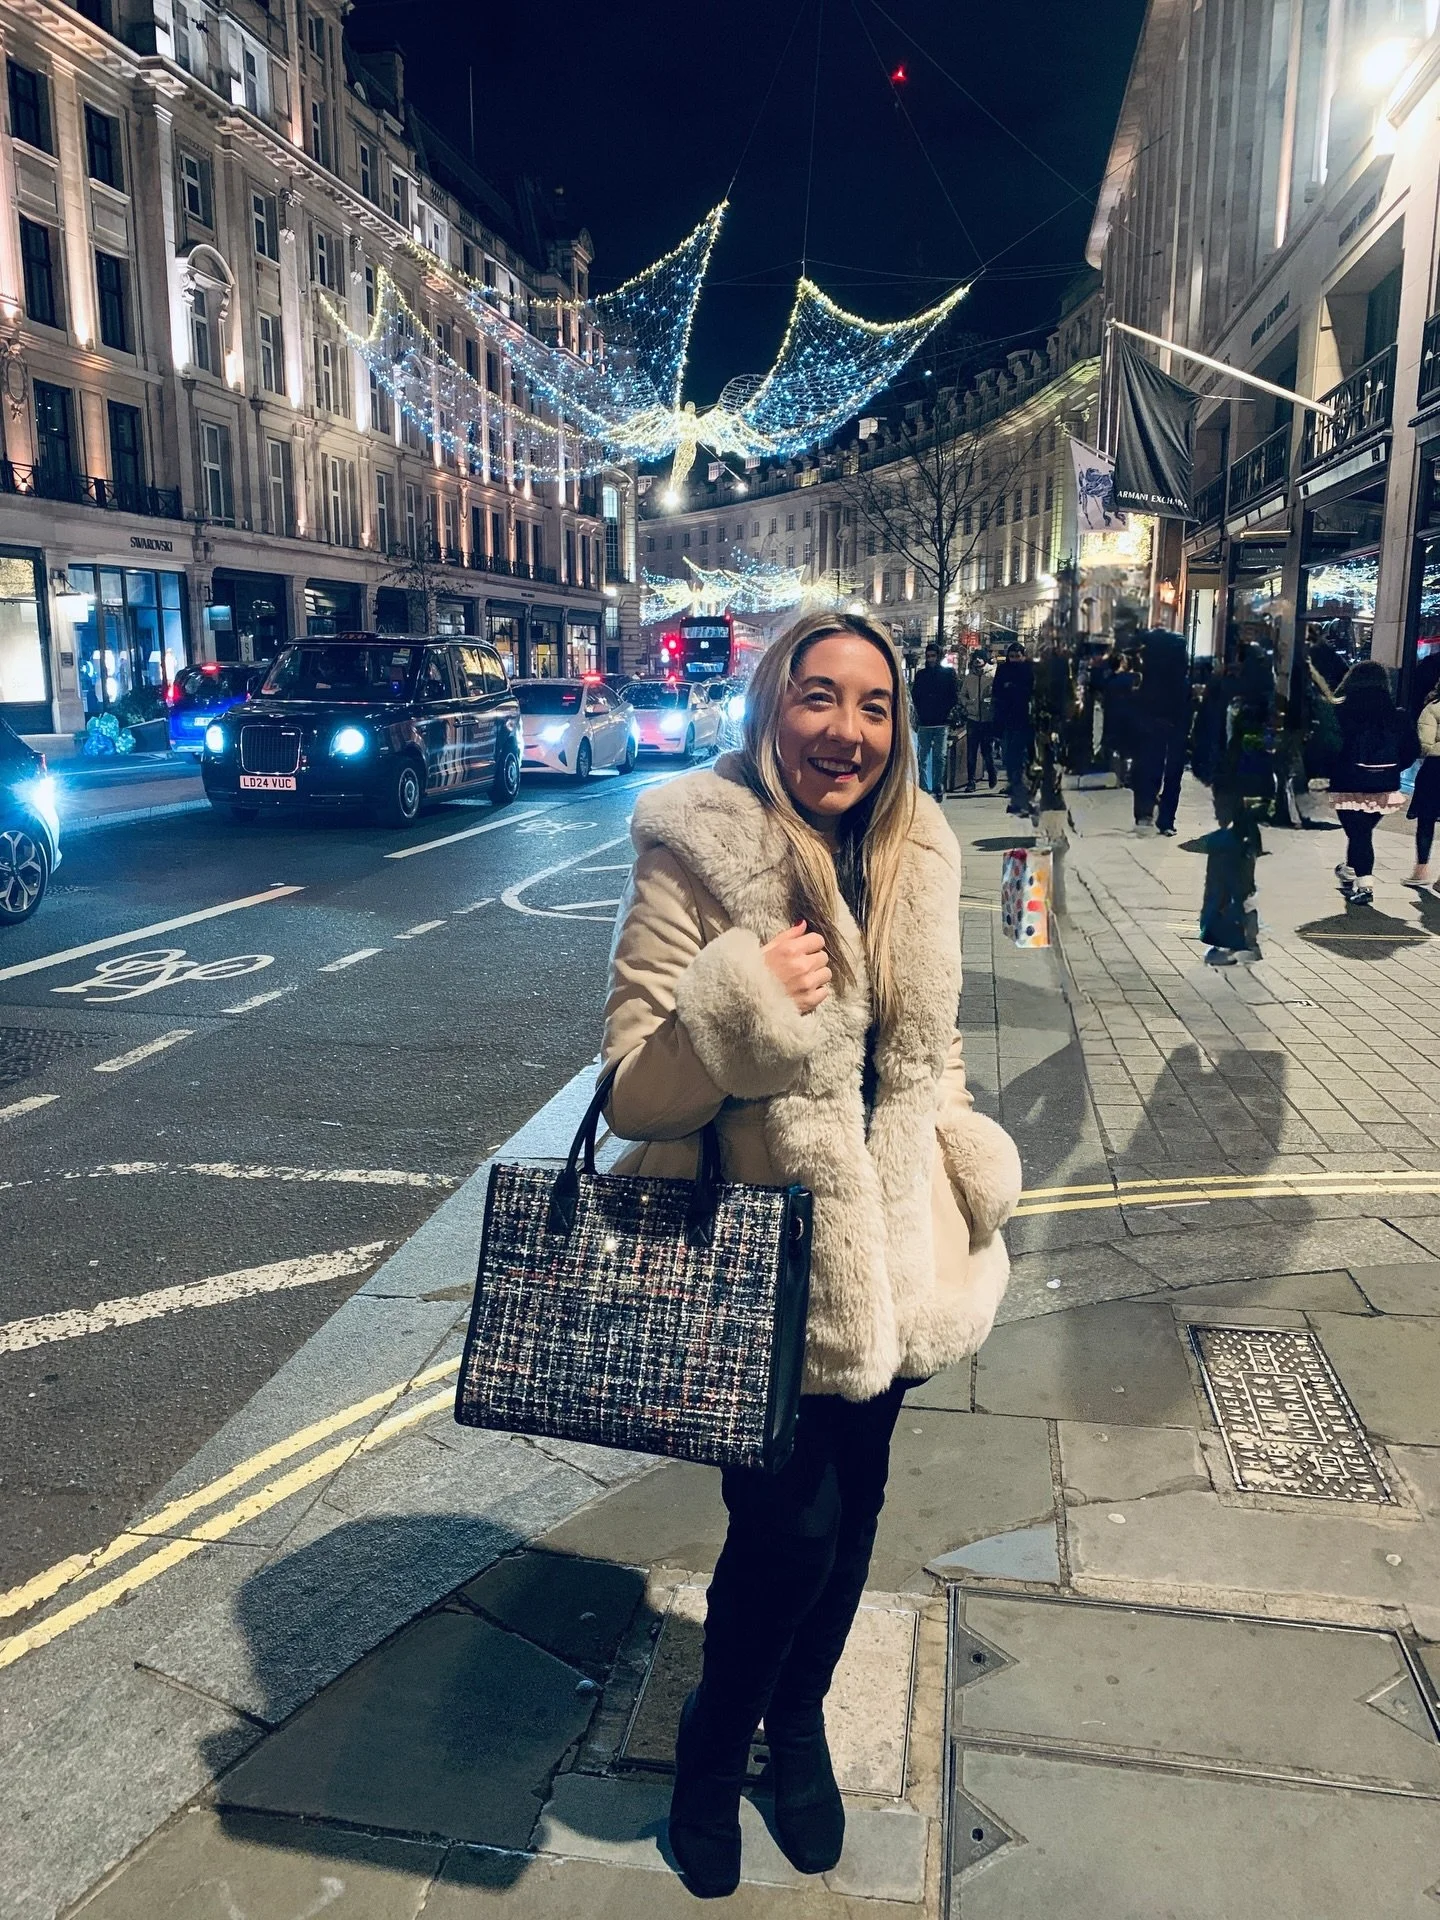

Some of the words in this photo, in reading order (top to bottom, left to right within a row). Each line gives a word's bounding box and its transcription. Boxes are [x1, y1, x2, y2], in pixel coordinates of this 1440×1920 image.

[1117, 490, 1149, 501] ARMANI
[130, 536, 173, 552] SWAROVSKI
[243, 778, 269, 788] LD24
[272, 779, 292, 789] VUC
[1253, 1387, 1283, 1422] FIRE
[1273, 1375, 1319, 1440] HYDRANT
